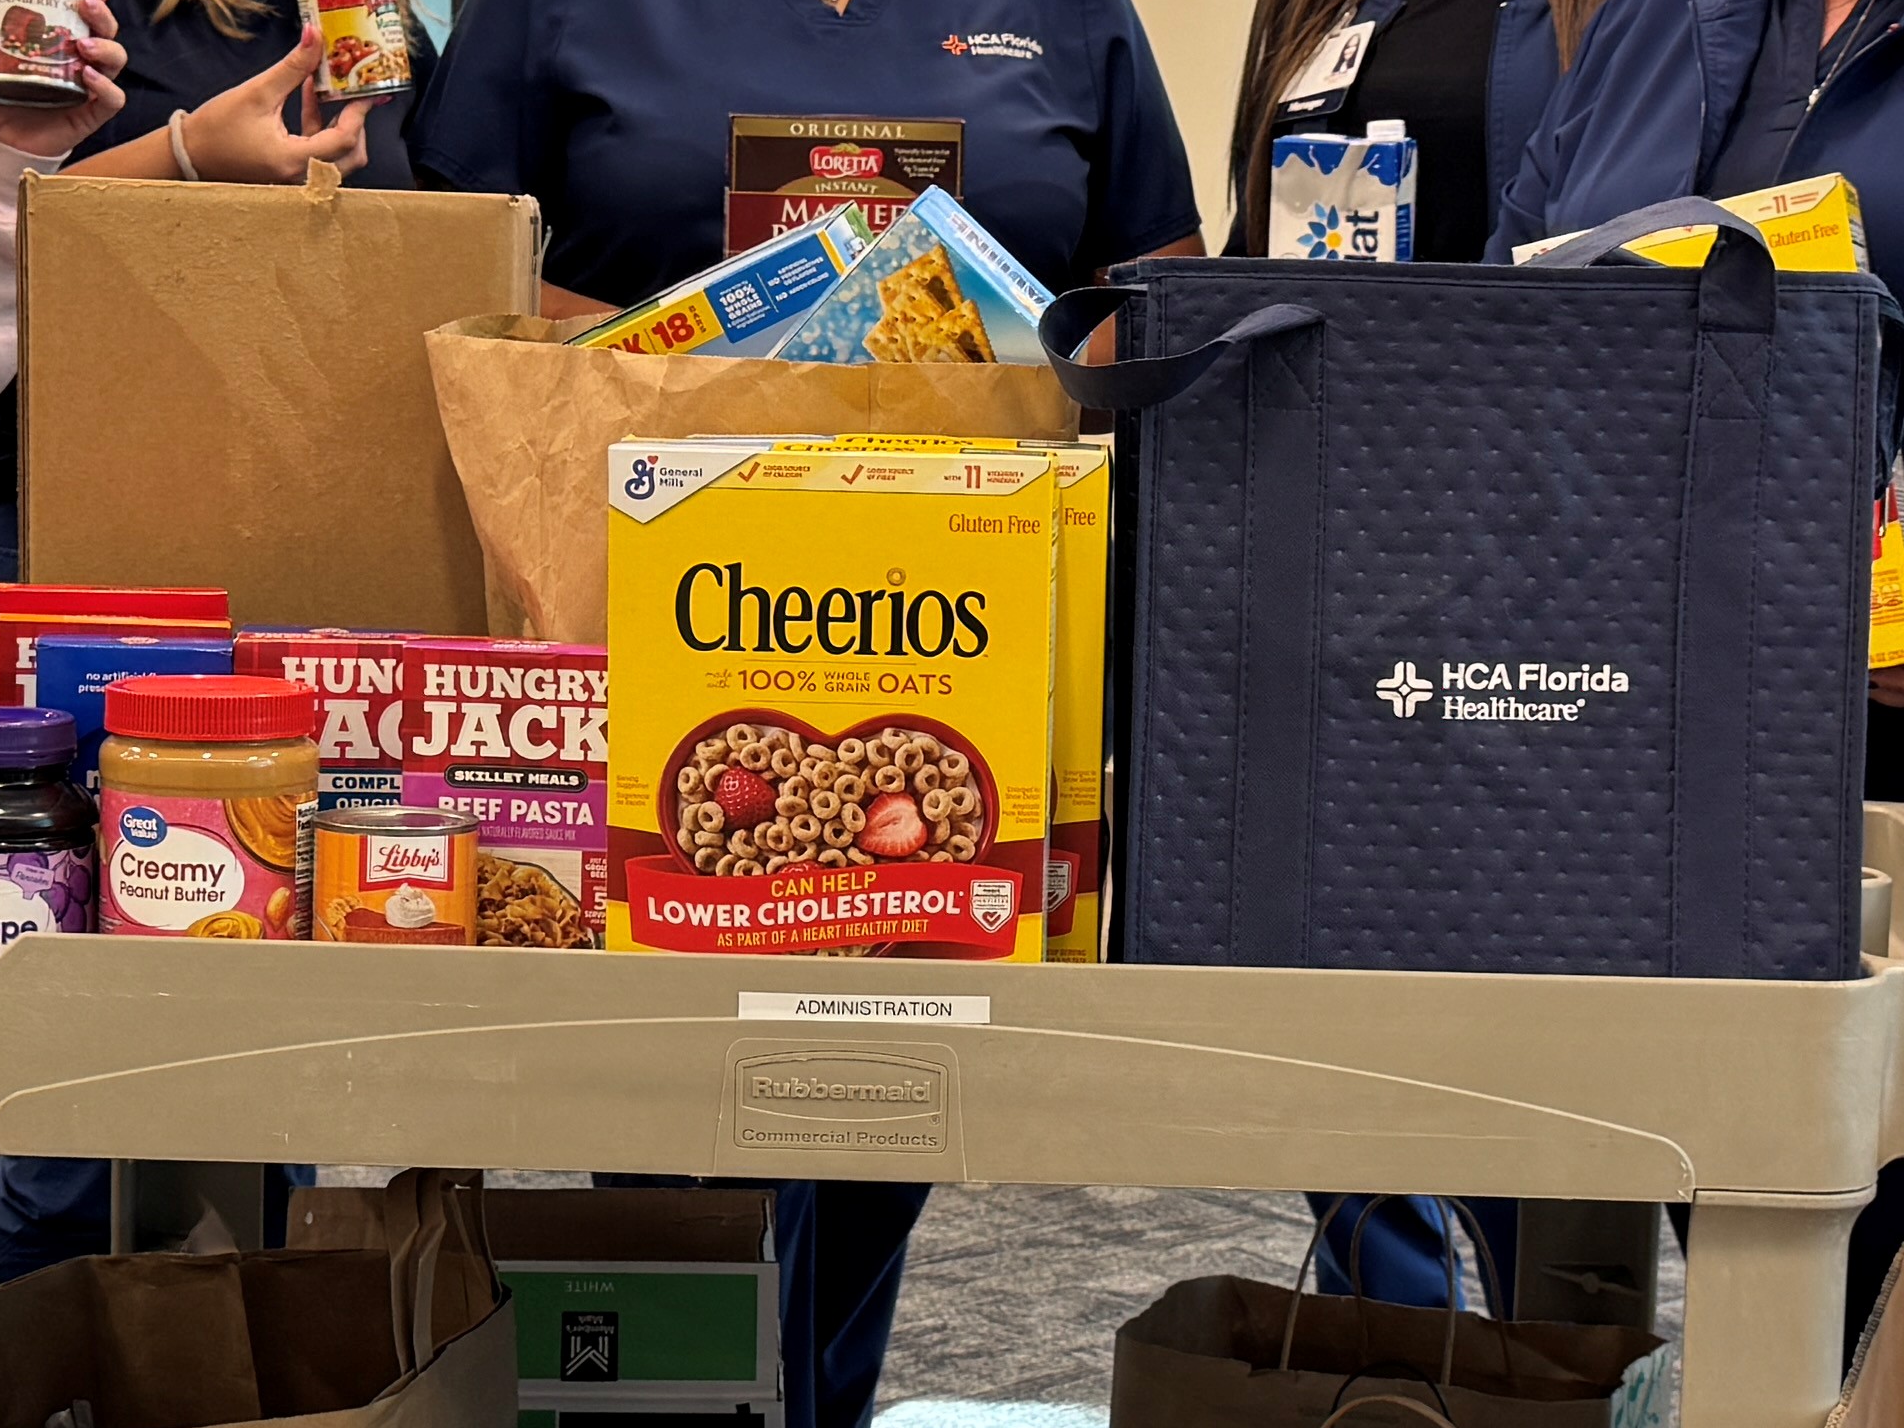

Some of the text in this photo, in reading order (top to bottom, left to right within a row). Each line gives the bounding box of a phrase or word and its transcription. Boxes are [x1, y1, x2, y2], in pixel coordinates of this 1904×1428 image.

[967, 34, 1002, 45] HCA
[790, 122, 906, 139] ORIGINAL
[813, 153, 880, 174] LORETTA
[815, 183, 879, 195] INSTANT
[1772, 195, 1788, 214] 11
[1768, 224, 1839, 248] Gluten Free
[719, 283, 756, 306] 100%
[724, 293, 760, 312] WHOLE
[652, 313, 696, 350] 18
[659, 467, 703, 479] General
[659, 477, 684, 489] Mills
[964, 465, 981, 489] 11
[949, 514, 1041, 535] Gluten Free
[1064, 507, 1097, 527] Free
[675, 562, 990, 658] Cheerios
[86, 672, 101, 682] no
[423, 664, 609, 702] HUNGRY
[738, 670, 817, 692] 100%
[823, 671, 871, 681] WHOLE
[877, 672, 953, 695] OATS
[1442, 663, 1630, 693] HCA Florida
[824, 681, 871, 693] GRAIN
[413, 700, 609, 763] JACK
[454, 770, 580, 787] SKILLET MEALS
[123, 813, 158, 830] Great
[510, 799, 594, 826] PASTA
[130, 827, 158, 840] Value
[120, 852, 225, 888] Creamy
[119, 881, 226, 903] Peanut Butter
[771, 871, 877, 898] CAN HELP
[648, 896, 750, 928] LOWER
[717, 919, 928, 947] AS PART OF A HEART HEALTHY DIET
[795, 999, 953, 1017] ADMINISTRATION
[751, 1076, 931, 1104] Rubbermaid
[742, 1128, 938, 1148] Commercial Products
[564, 1280, 615, 1293] WHITE
